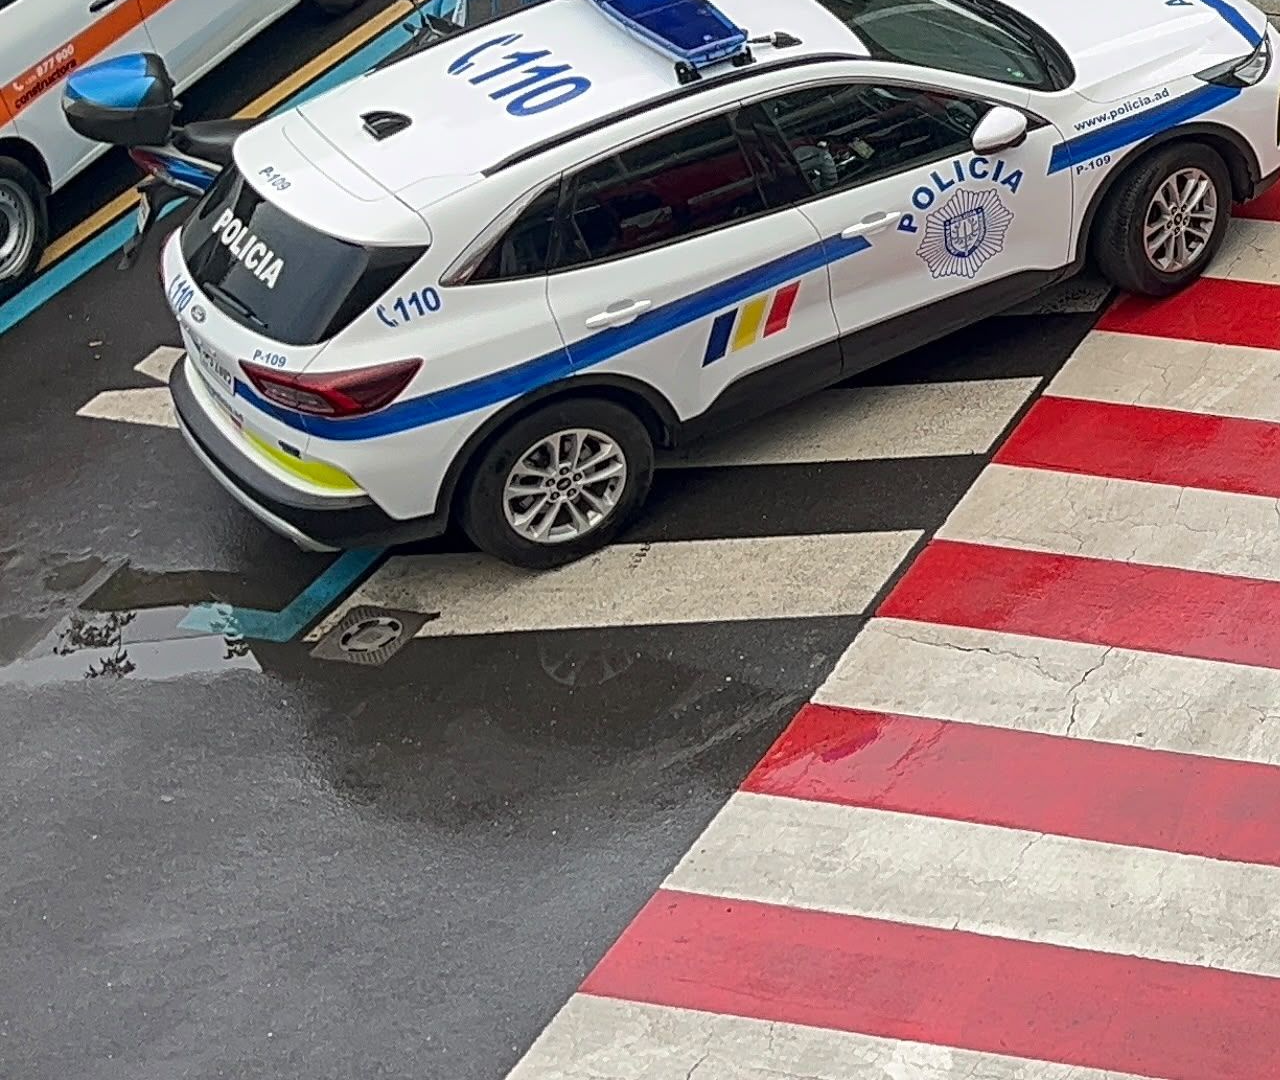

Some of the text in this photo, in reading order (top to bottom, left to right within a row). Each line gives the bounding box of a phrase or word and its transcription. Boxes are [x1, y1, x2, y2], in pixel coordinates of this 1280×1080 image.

[468, 49, 592, 117] 110
[1073, 88, 1170, 131] www.policia.ad
[258, 166, 292, 191] P-109
[1076, 154, 1111, 175] P-109
[897, 156, 1025, 234] POLICIA
[212, 209, 286, 290] POLICIA
[393, 286, 442, 322] 110
[253, 349, 287, 368] P-109
